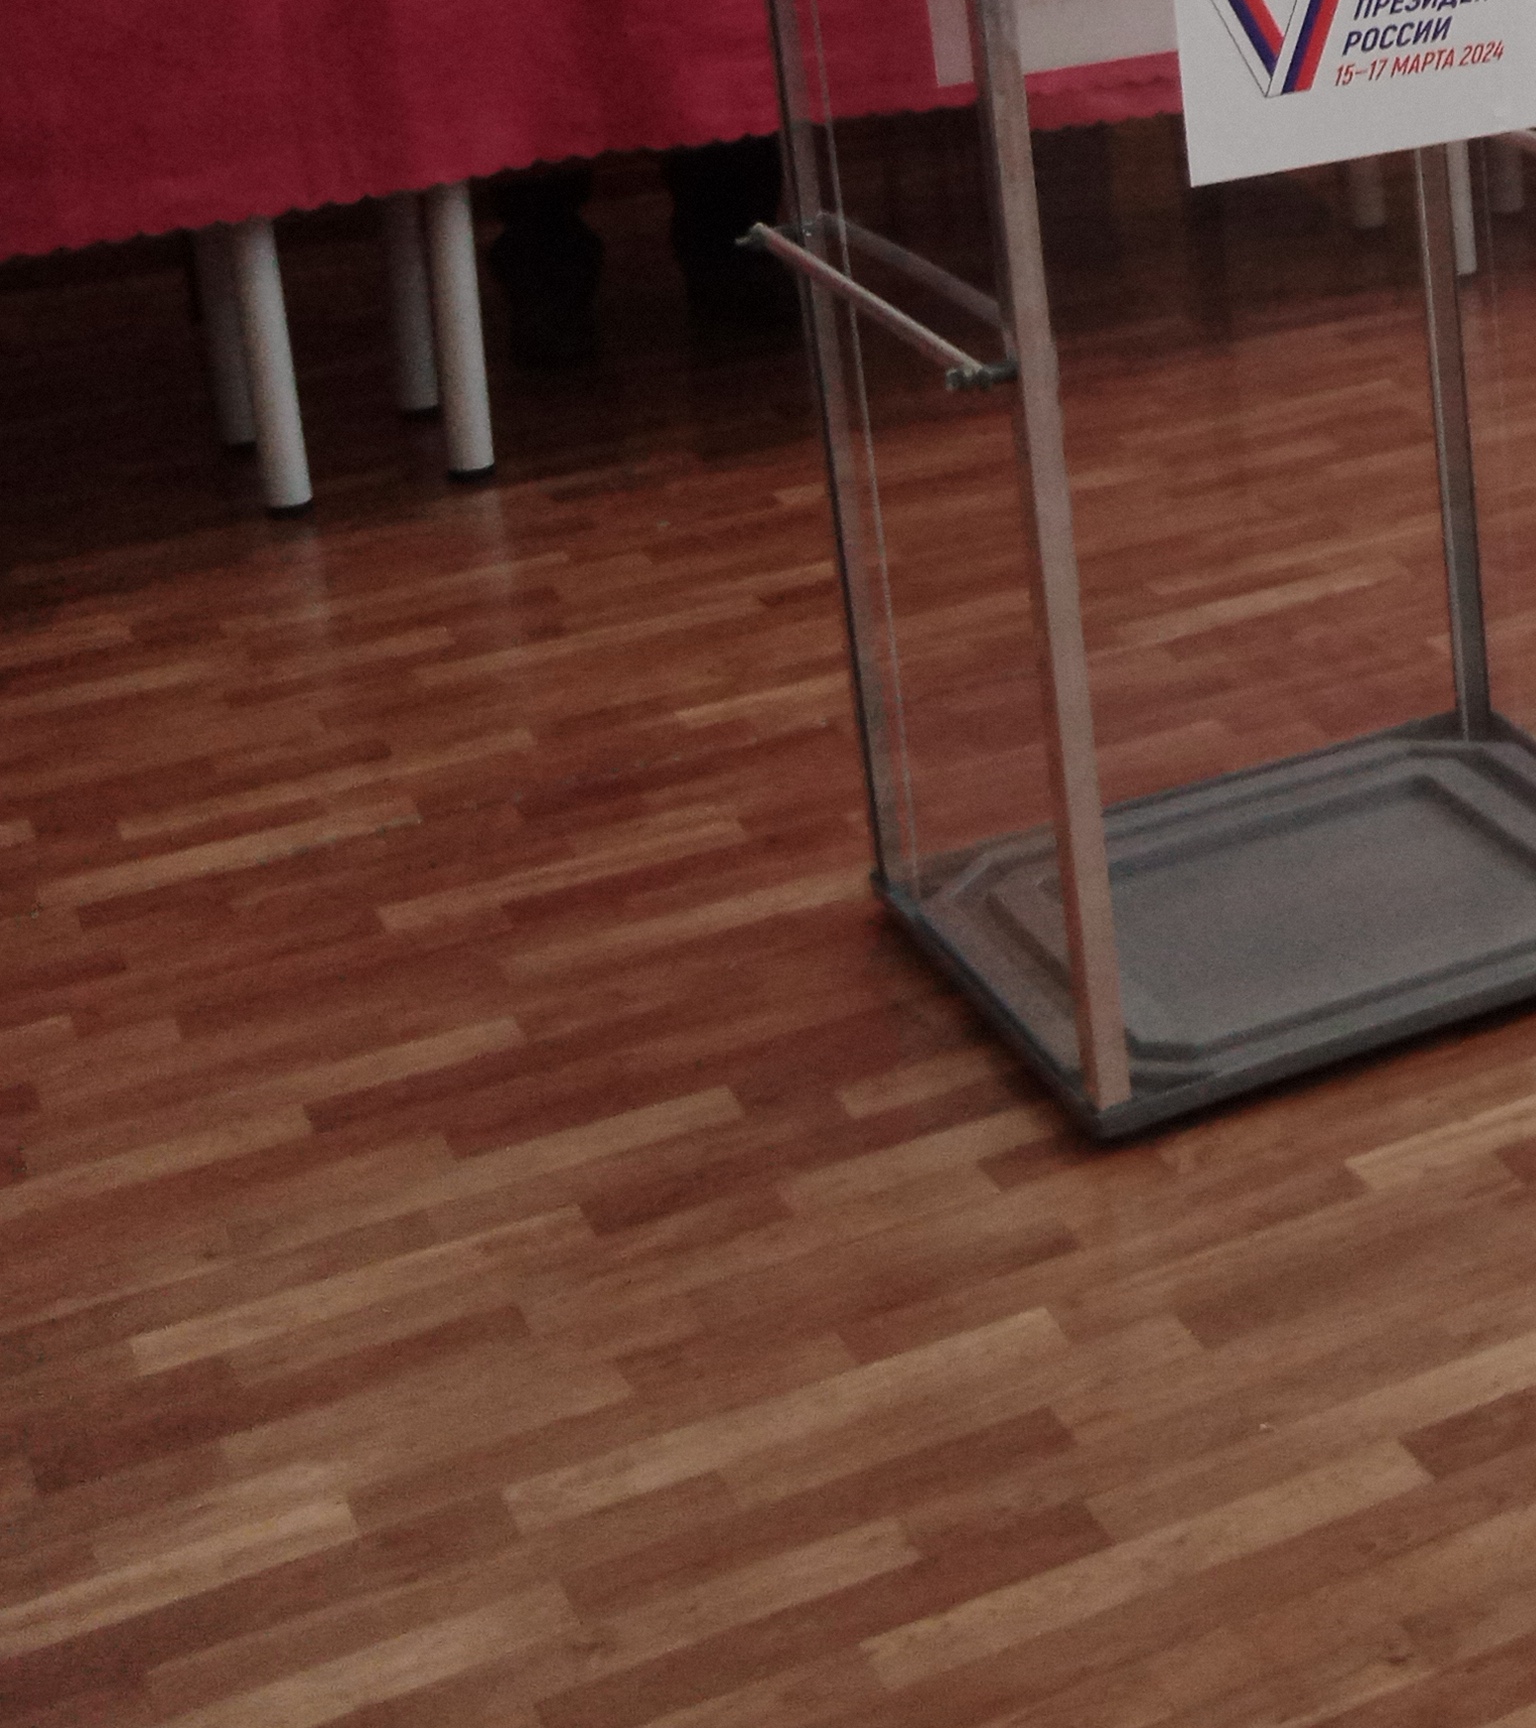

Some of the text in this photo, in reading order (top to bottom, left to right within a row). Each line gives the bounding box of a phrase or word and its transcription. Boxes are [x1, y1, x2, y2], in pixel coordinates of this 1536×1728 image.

[1342, 16, 1452, 56] РОССИИ
[1335, 40, 1505, 86] 15–17 МАРТА 2024
